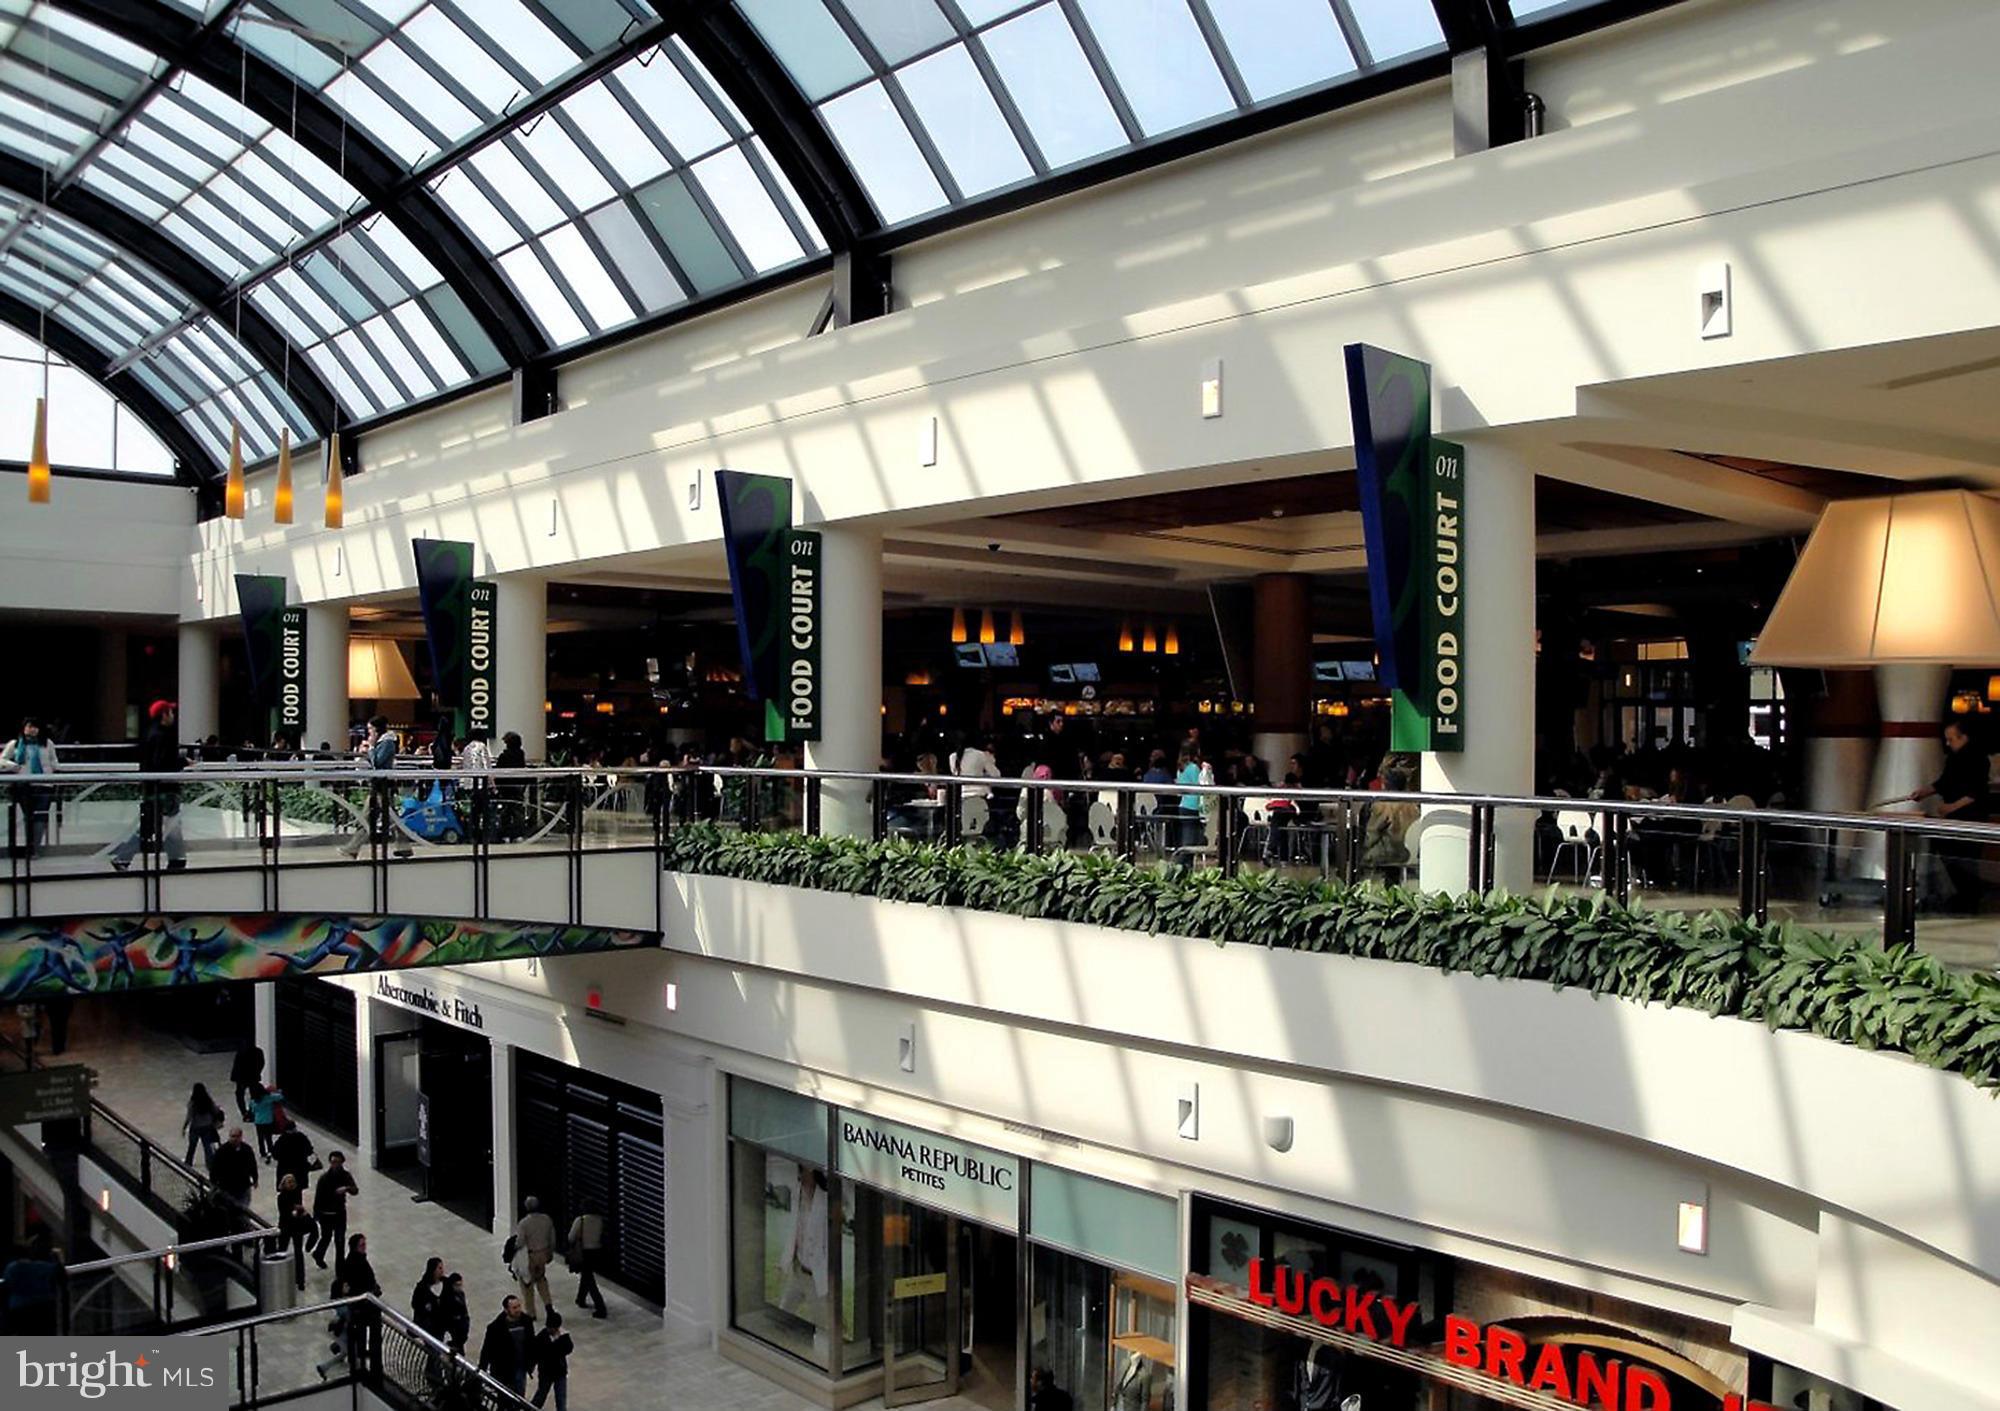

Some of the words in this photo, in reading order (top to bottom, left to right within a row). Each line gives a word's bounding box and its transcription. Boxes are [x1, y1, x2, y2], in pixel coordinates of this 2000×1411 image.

[1435, 455, 1458, 480] on
[791, 539, 814, 557] on
[1436, 491, 1459, 617] COURT
[283, 612, 300, 623] on
[470, 588, 490, 601] on
[791, 564, 813, 650] COURT
[283, 627, 300, 678] COURT
[471, 607, 490, 671] COURT
[283, 683, 300, 725] FOOD
[470, 677, 490, 730] FOOD
[791, 658, 813, 730] FOOD
[1436, 632, 1459, 734] FOOD
[377, 973, 439, 1014] Abercrombie
[442, 999, 452, 1018] &
[454, 998, 484, 1029] Fitch
[844, 1122, 916, 1163] BANANA
[919, 1145, 1013, 1191] REPUBLIC
[901, 1165, 946, 1191] PETITES
[1248, 1256, 1419, 1347] LUCKY
[1445, 1313, 1672, 1411] BRAND
